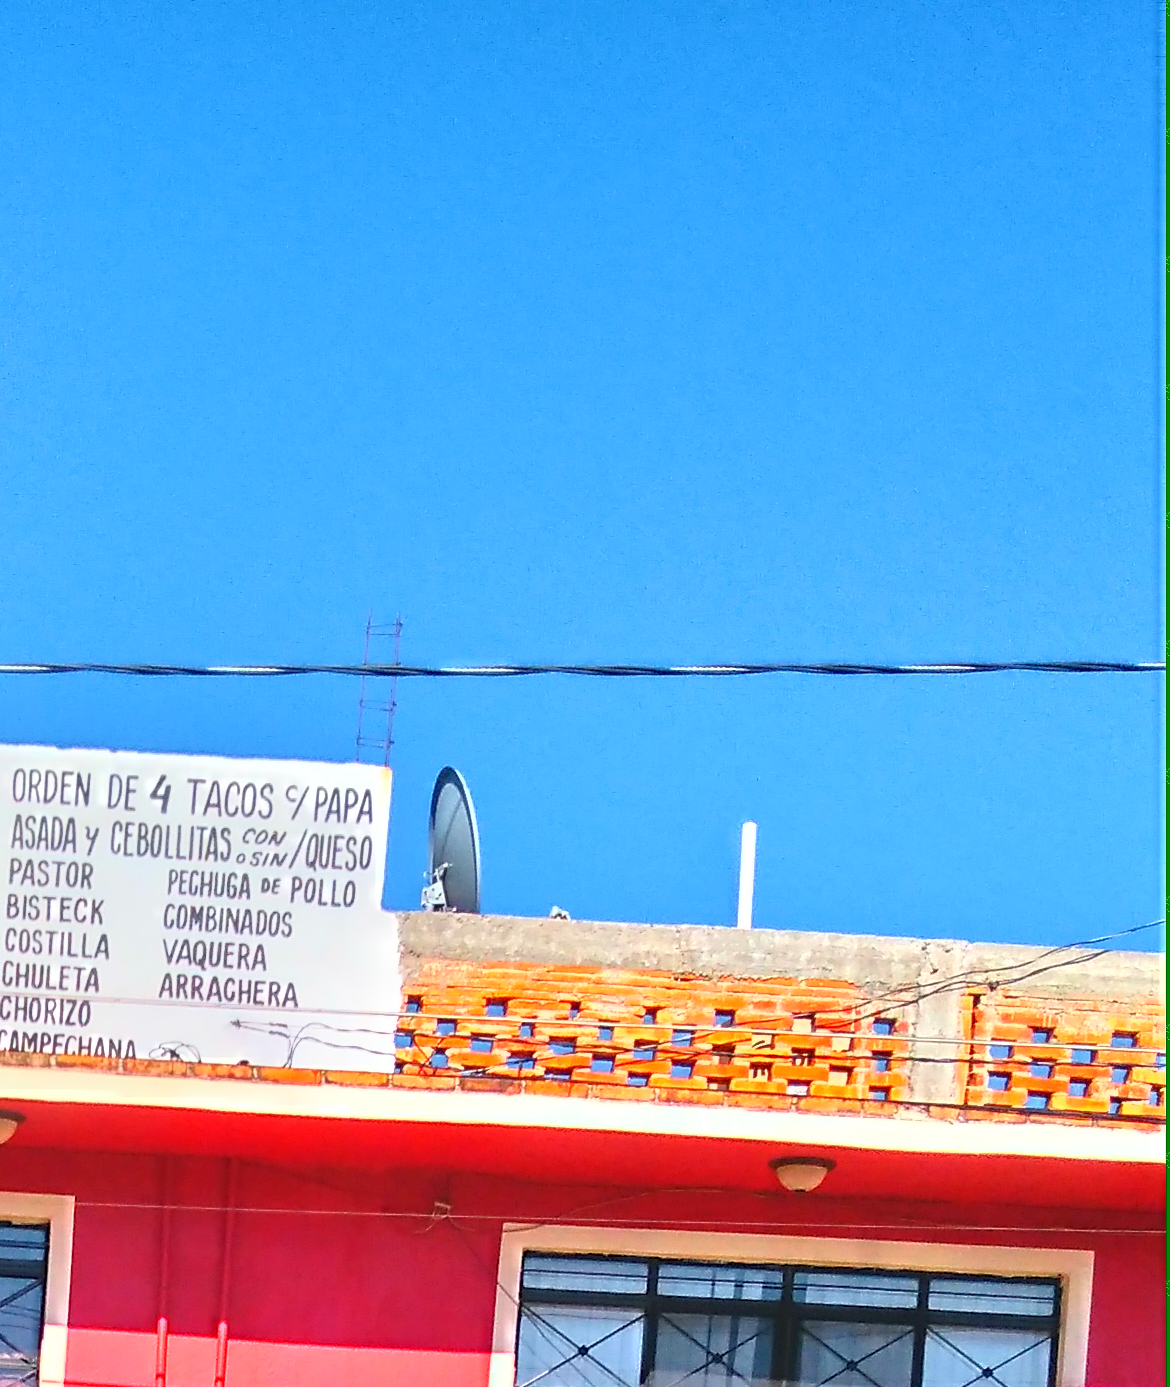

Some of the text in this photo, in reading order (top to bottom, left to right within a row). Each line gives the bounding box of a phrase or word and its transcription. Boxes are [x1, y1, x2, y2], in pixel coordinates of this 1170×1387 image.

[12, 768, 91, 807] ORDEN
[107, 773, 138, 812] DE
[150, 774, 171, 814] 4
[187, 778, 274, 820] TACOS
[11, 814, 77, 854] ASADA
[110, 821, 231, 863] CEBOLLITAS
[242, 828, 287, 846] CON
[8, 858, 93, 890] PASTOR
[250, 852, 288, 867] SIN
[167, 869, 356, 908] PECHUGA DE POLLO
[7, 894, 104, 926] BISTECK
[163, 904, 293, 938] COMBINADOS
[5, 928, 109, 960] COSTILLA
[163, 939, 267, 972] VAQUERA
[2, 961, 99, 993] CHULETA
[159, 973, 298, 1008] ARRACHERA
[0, 996, 91, 1027] CHORIZO
